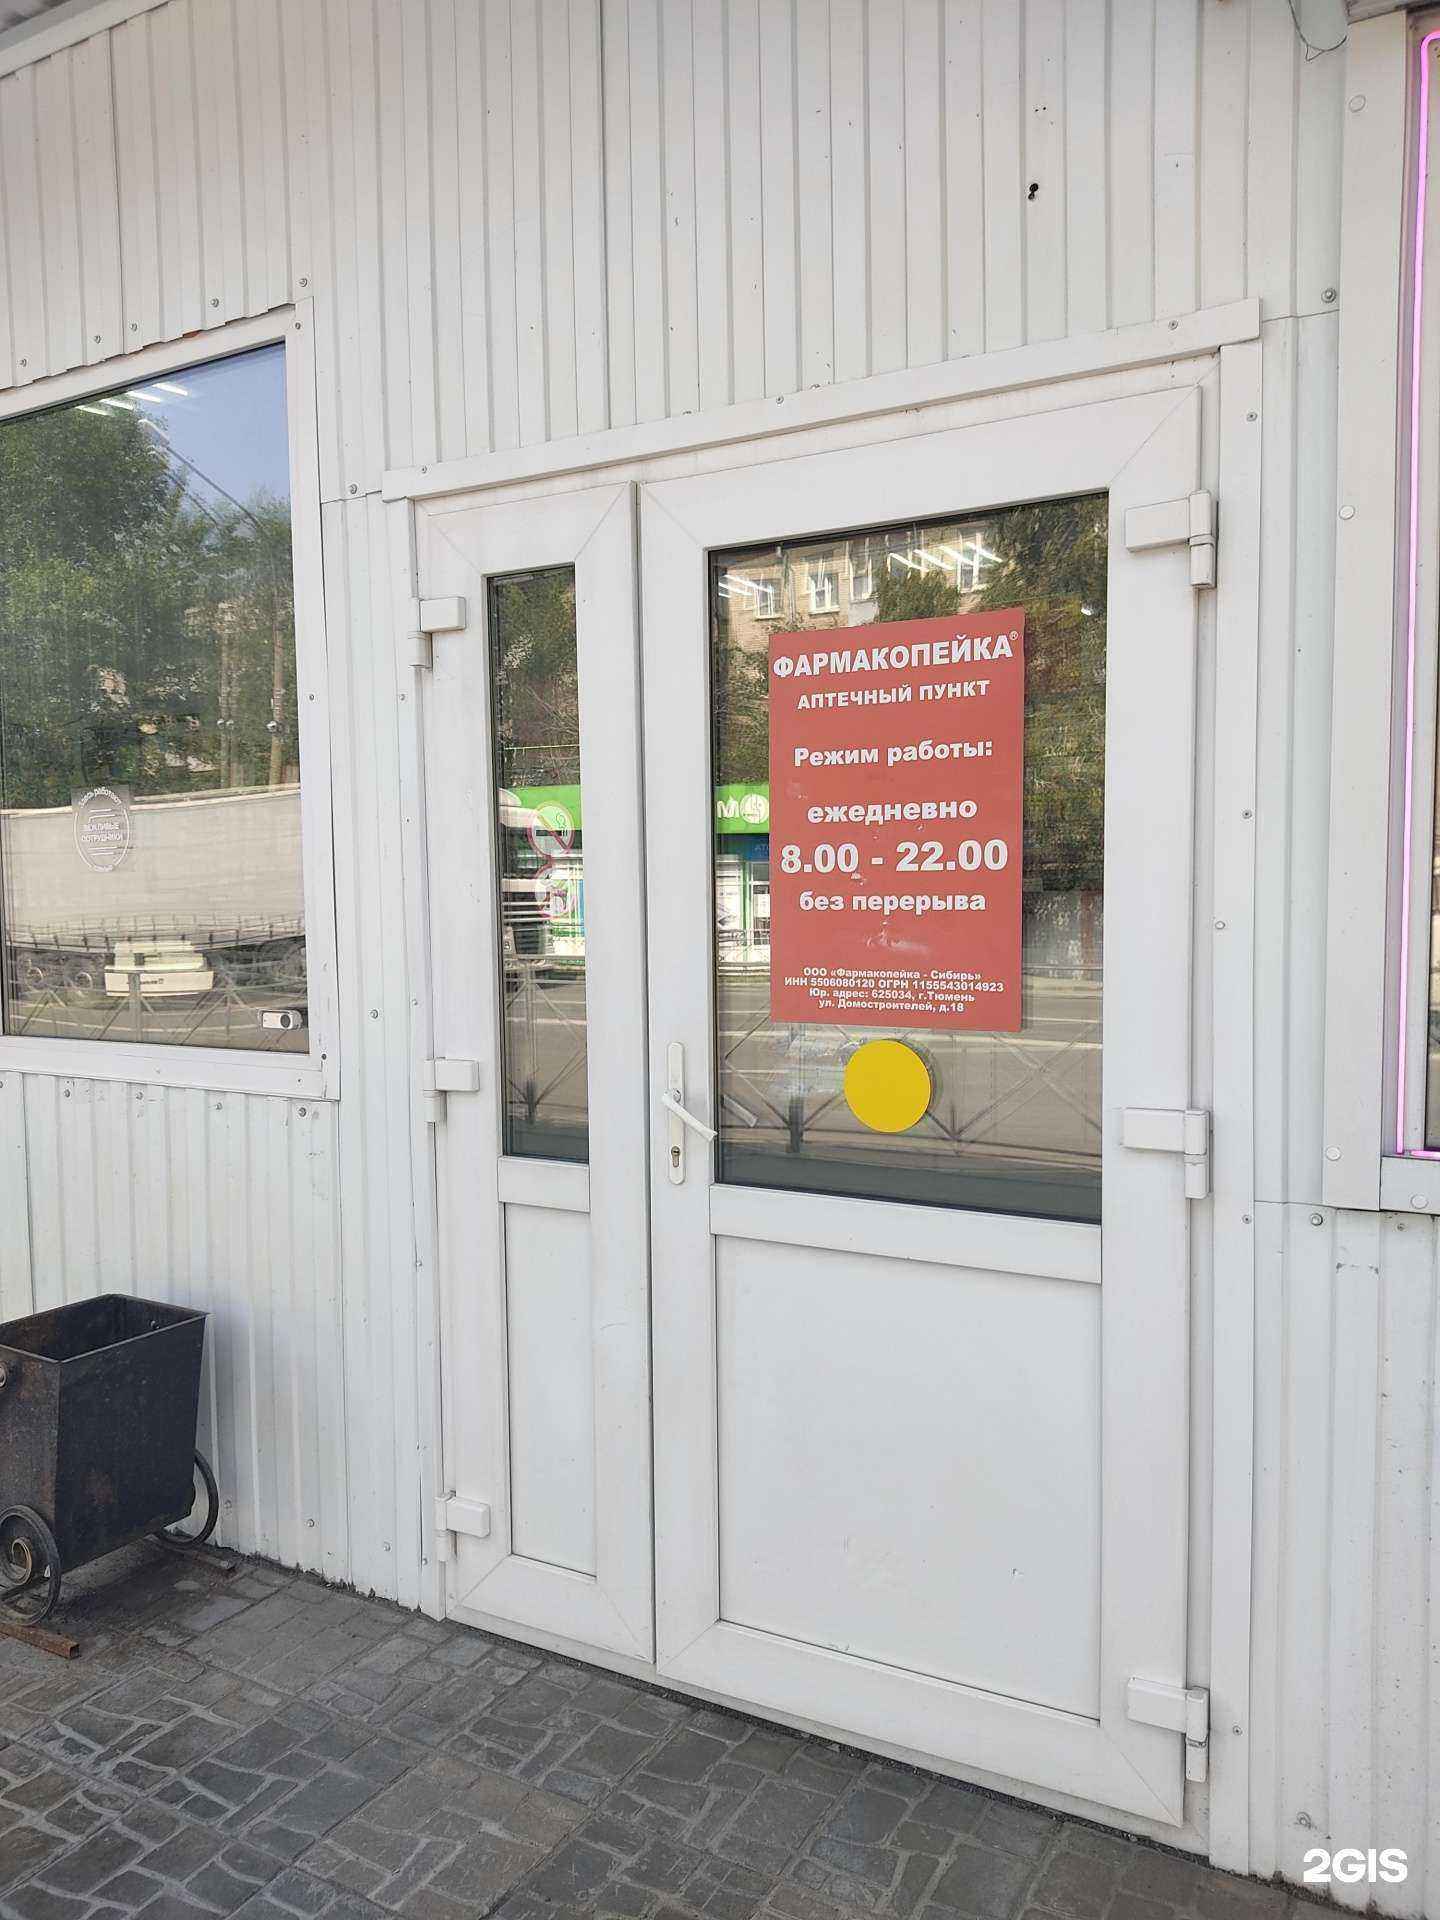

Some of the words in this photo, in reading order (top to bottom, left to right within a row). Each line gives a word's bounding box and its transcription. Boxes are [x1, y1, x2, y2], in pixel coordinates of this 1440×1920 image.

[797, 684, 912, 709] АПТЕЧНЫЙ
[919, 679, 990, 700] ПУНКТ
[794, 747, 879, 766] Режим
[887, 740, 993, 766] работы:
[807, 800, 977, 825] ежедневно
[781, 843, 859, 873] 8.00
[896, 839, 1008, 871] 22.00
[799, 891, 844, 910] без
[853, 892, 986, 915] перерыва
[784, 977, 808, 986] ИНН
[878, 979, 909, 989] ОГРН
[803, 967, 827, 976] ООО
[831, 968, 920, 980] «Фармакопейка
[931, 970, 981, 981] Сибирь»
[809, 988, 830, 998] Юр.
[832, 990, 869, 999] адрес:
[871, 989, 915, 1000] 625034,
[819, 999, 835, 1008] ул.
[837, 999, 936, 1012] Домостроителей,
[939, 1002, 964, 1013] д.18
